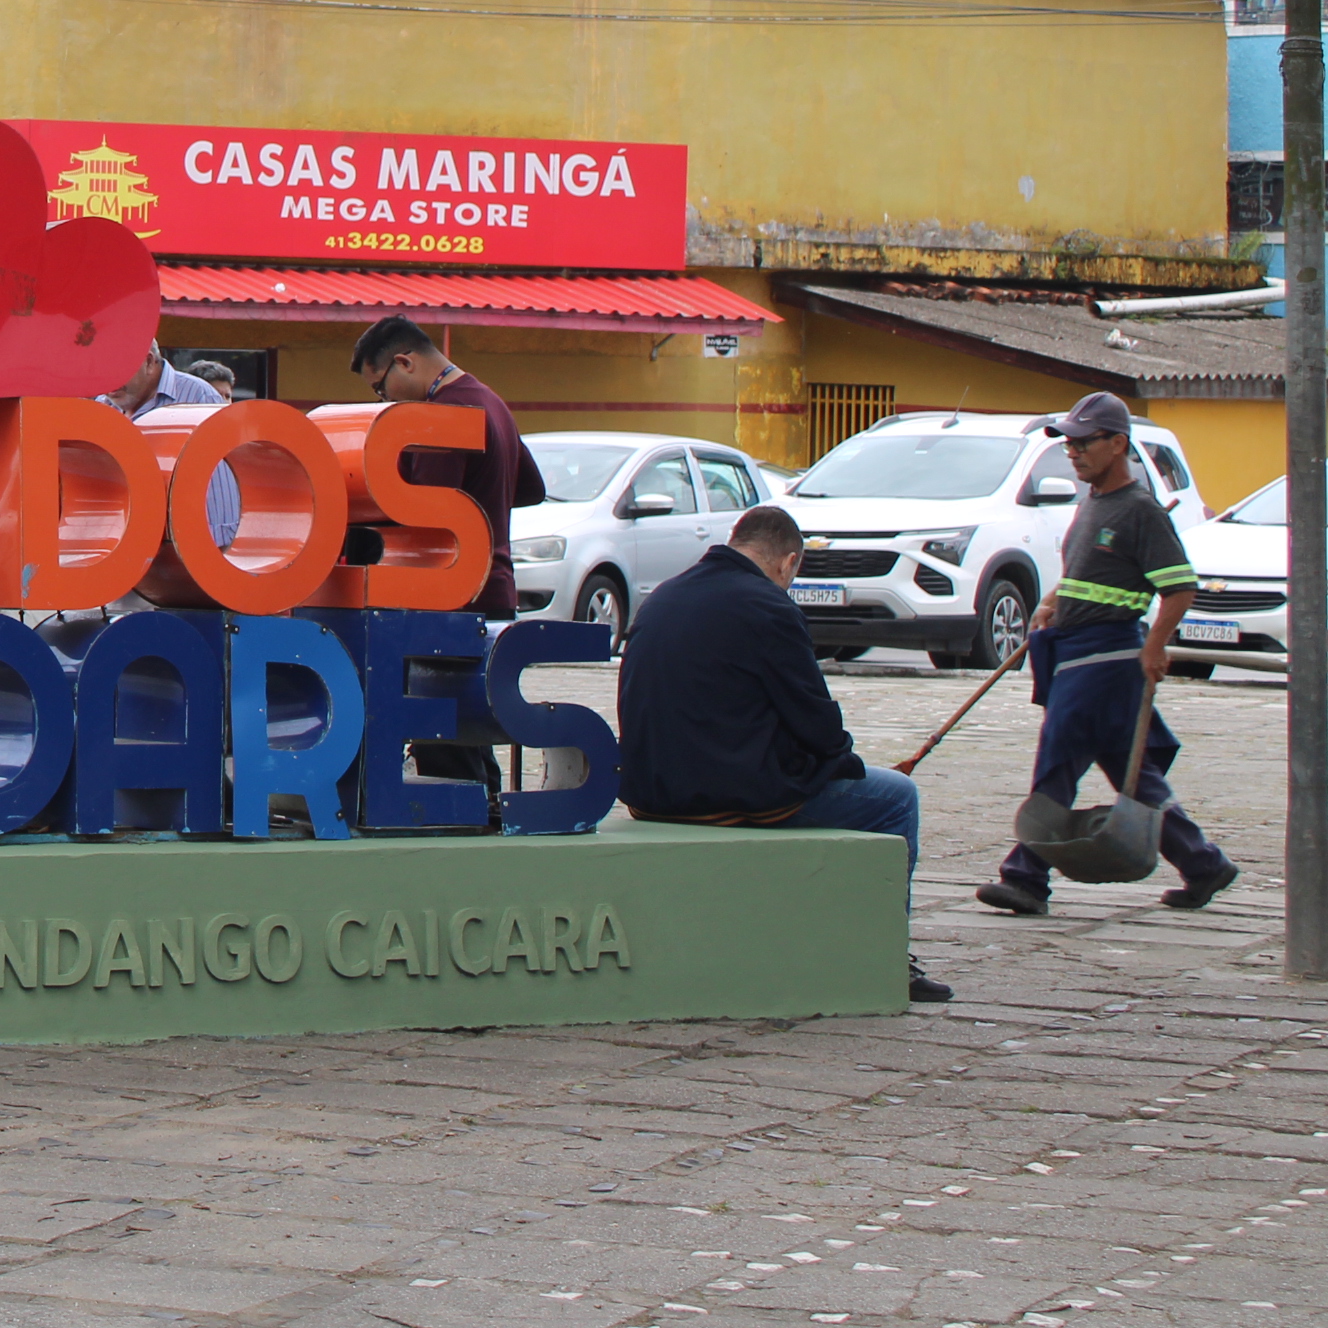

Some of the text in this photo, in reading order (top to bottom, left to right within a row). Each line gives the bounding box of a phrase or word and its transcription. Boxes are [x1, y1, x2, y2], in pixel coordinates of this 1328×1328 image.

[183, 140, 636, 198] CASAS MARINGÁ
[86, 193, 121, 216] CM
[280, 195, 529, 228] MEGA STORE
